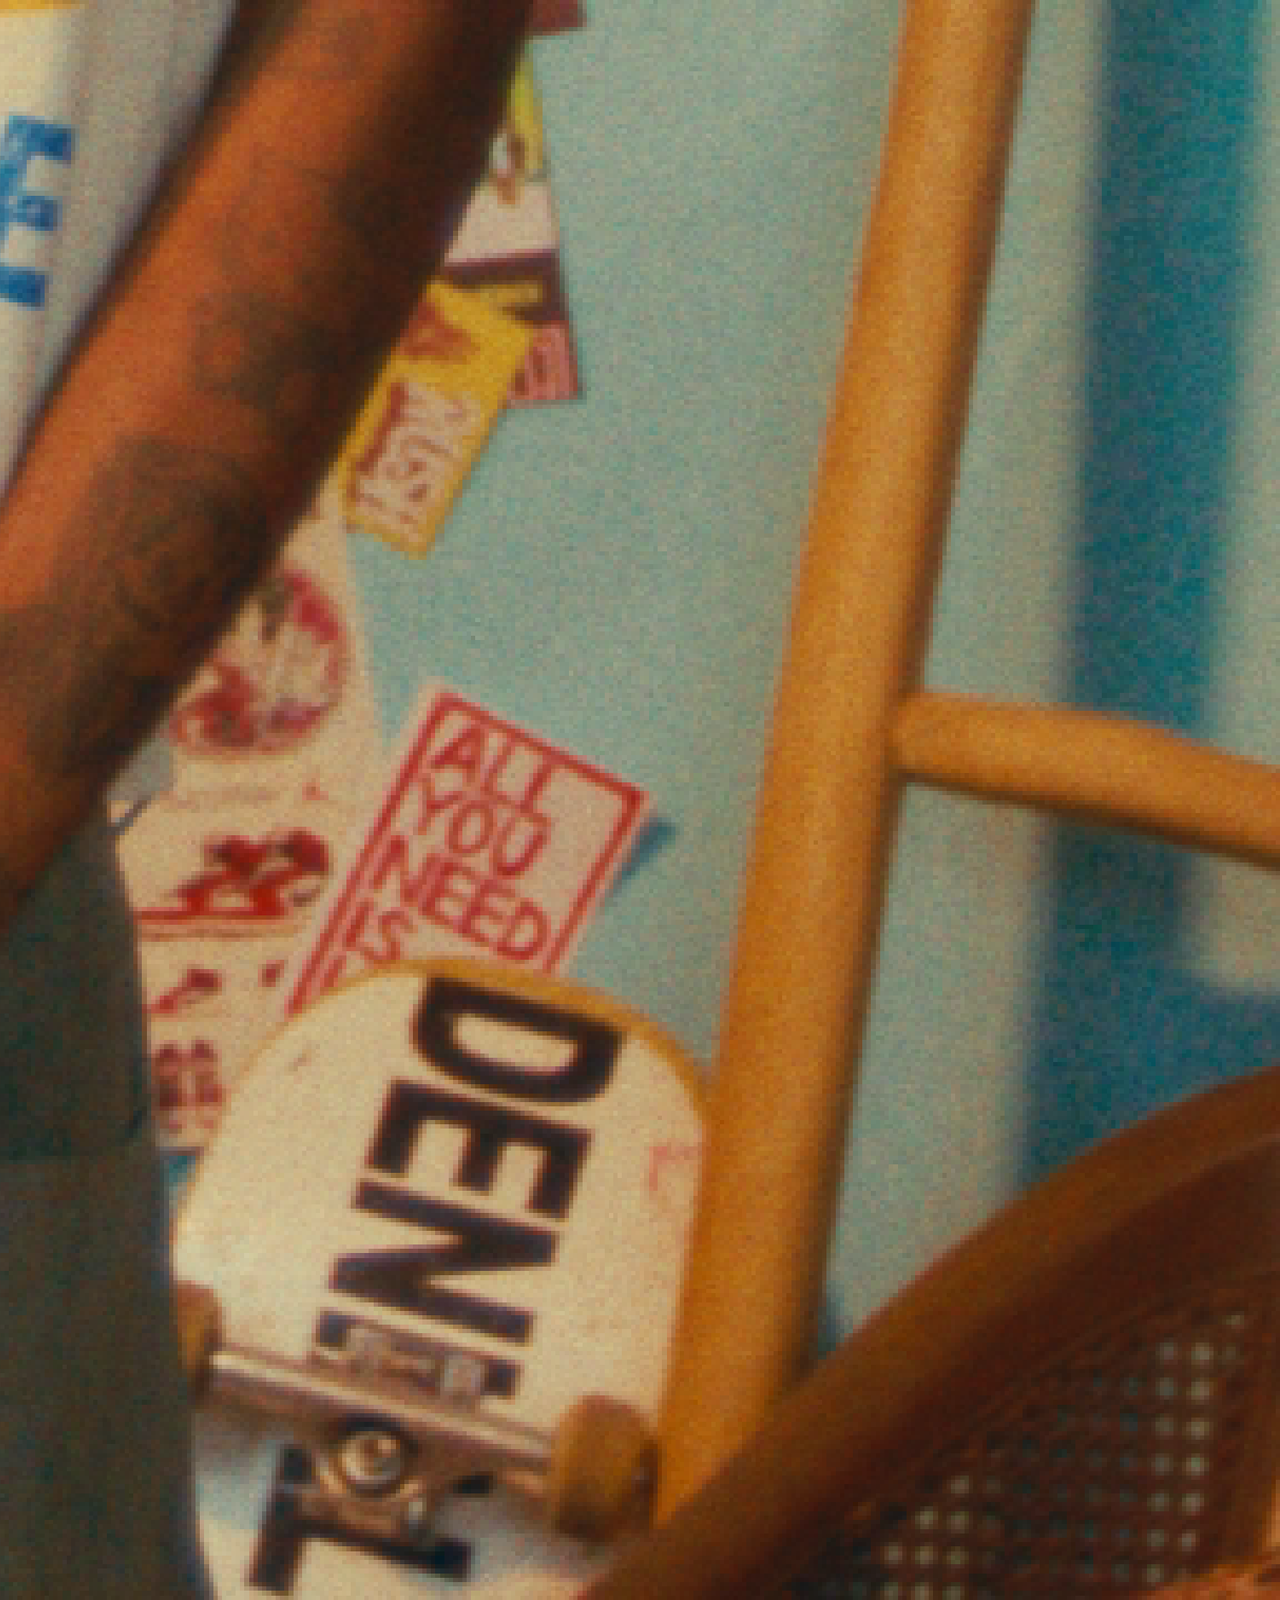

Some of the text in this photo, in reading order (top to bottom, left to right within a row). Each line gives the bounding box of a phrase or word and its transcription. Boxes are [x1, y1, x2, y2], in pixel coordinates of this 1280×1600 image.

[430, 720, 560, 812] ALL
[418, 770, 552, 878] YOU
[344, 900, 416, 965] IS
[372, 834, 548, 962] NEED
